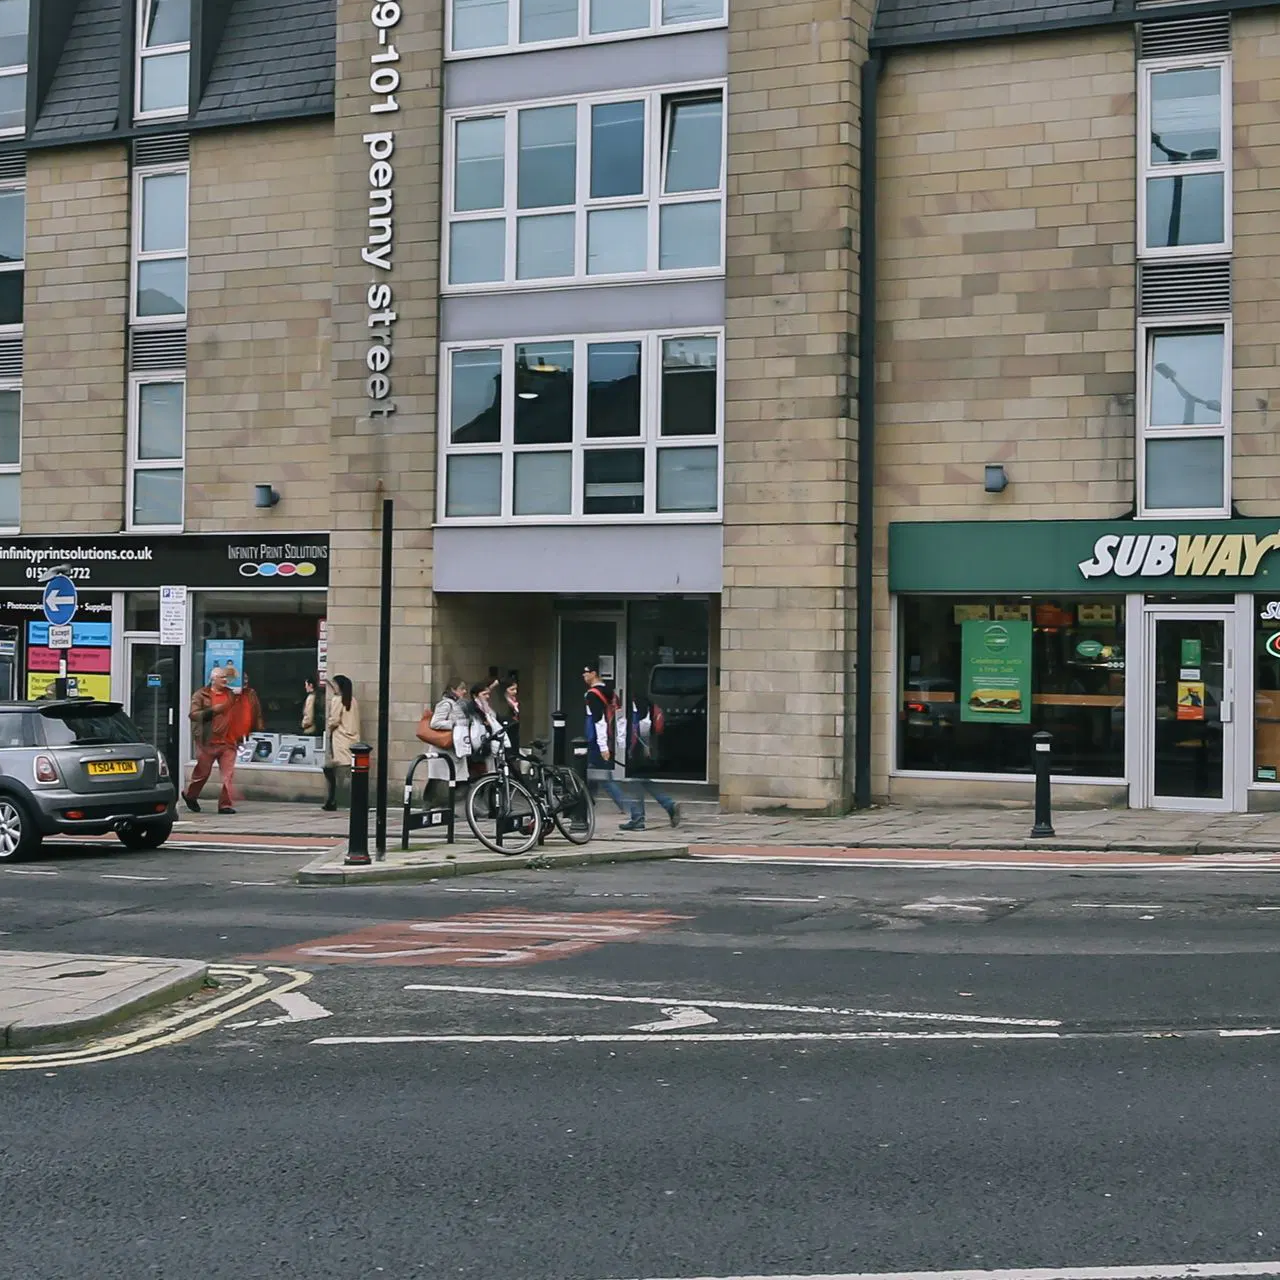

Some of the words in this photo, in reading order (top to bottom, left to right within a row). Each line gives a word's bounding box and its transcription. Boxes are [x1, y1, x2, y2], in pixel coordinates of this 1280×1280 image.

[362, 131, 396, 270] penny
[366, 282, 397, 418] street
[7, 601, 44, 611] Photocopie
[51, 628, 70, 637] Except
